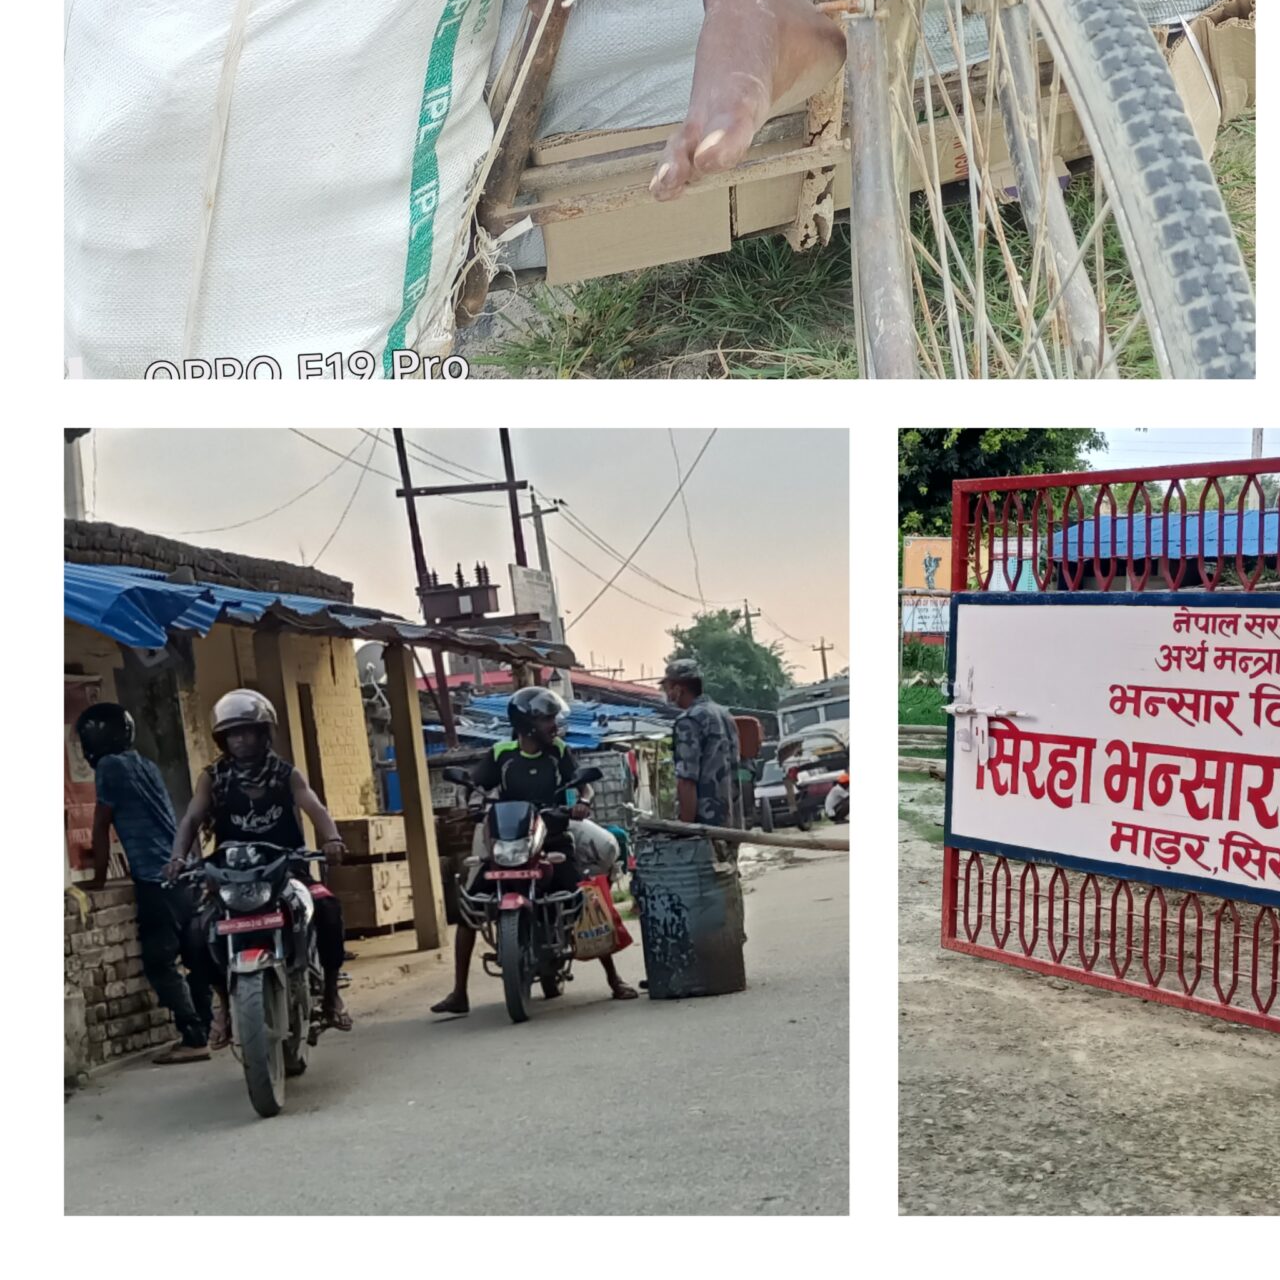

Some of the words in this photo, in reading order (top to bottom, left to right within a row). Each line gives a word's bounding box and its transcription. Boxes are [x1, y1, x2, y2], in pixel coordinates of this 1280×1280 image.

[418, 85, 450, 144] IPL
[1173, 606, 1242, 638] नेपाल
[1155, 640, 1209, 672] अर्थ
[1109, 684, 1243, 736] भन्सार
